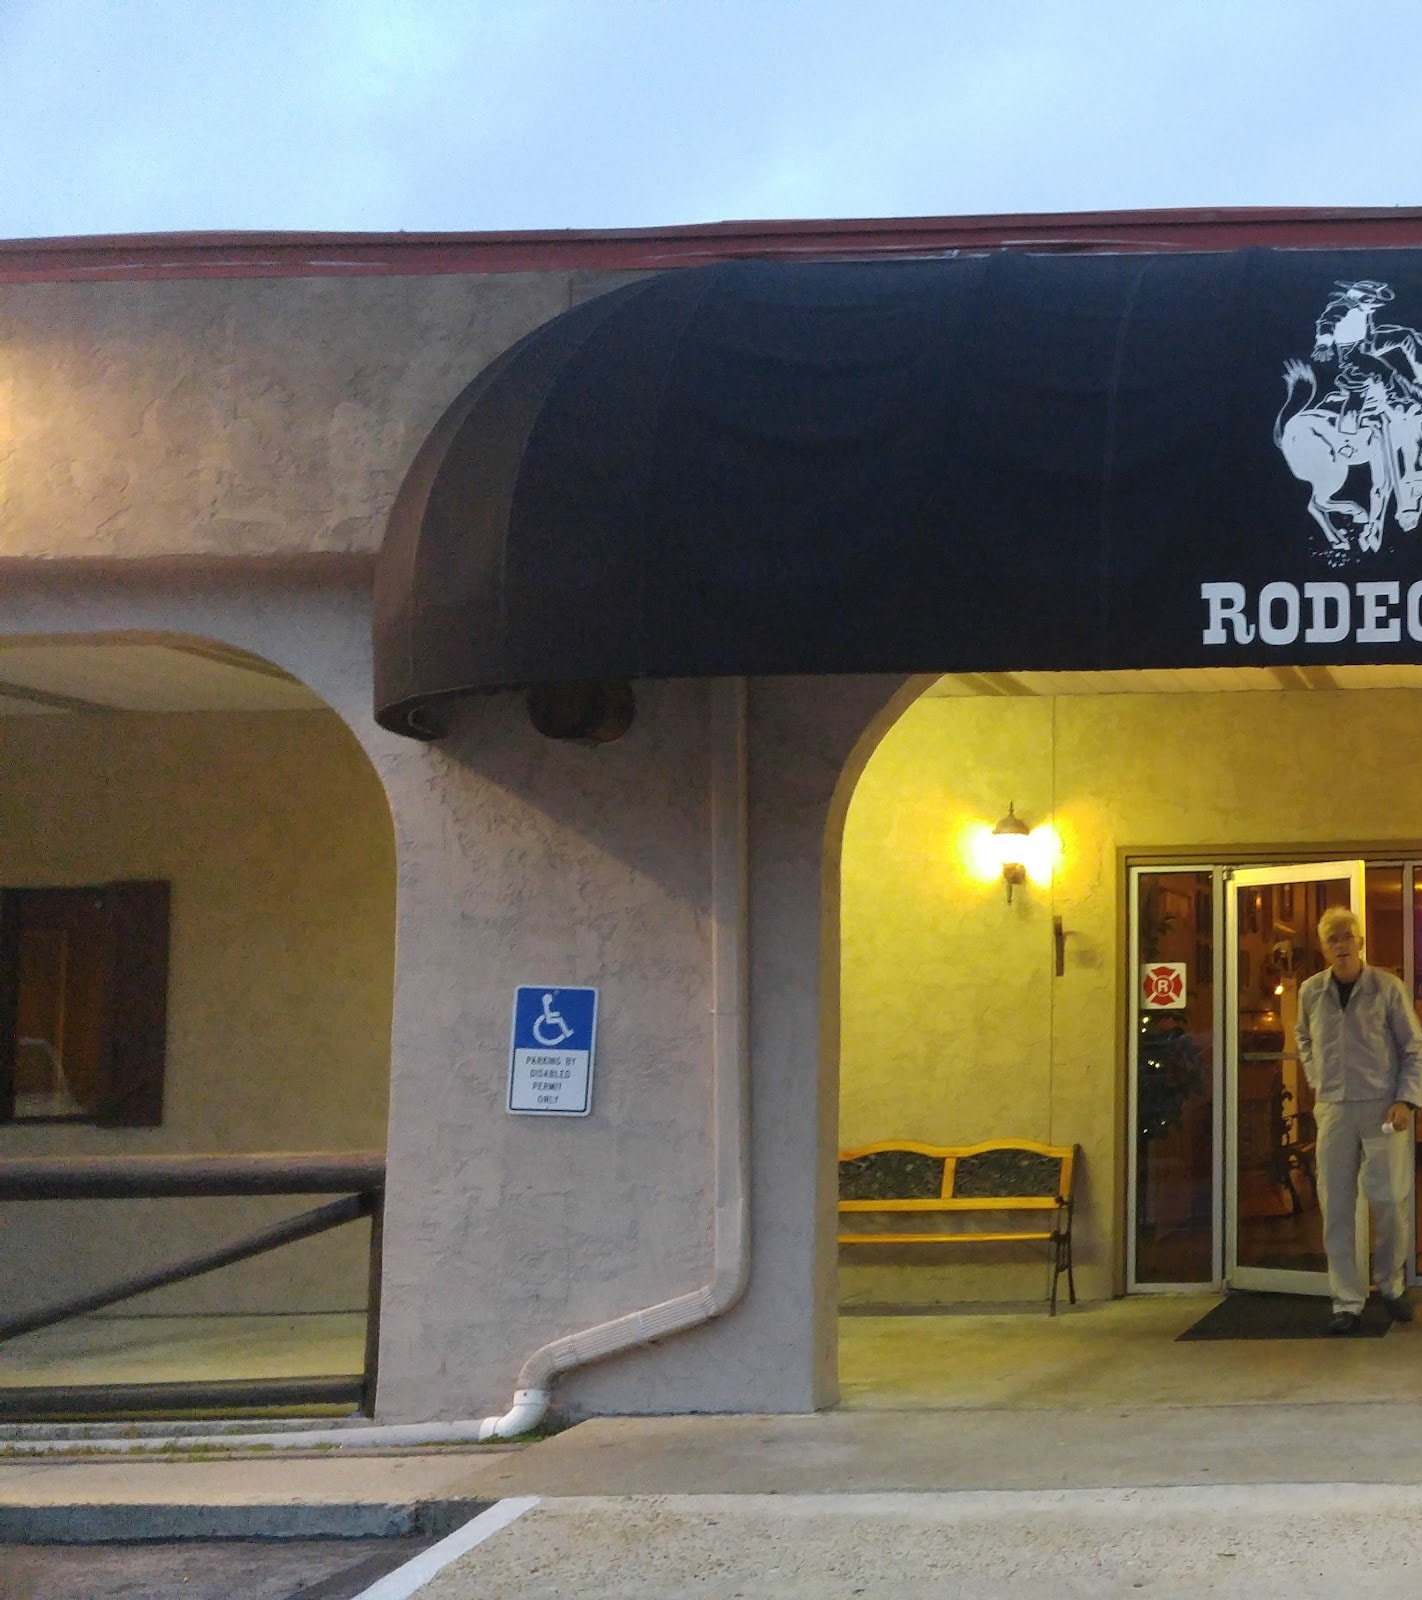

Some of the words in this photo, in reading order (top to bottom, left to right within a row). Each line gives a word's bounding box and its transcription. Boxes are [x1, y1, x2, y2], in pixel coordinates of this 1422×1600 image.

[1157, 979, 1169, 993] R
[525, 1056, 561, 1065] PARKING
[565, 1057, 576, 1066] BY
[530, 1069, 571, 1079] DISABLED
[532, 1081, 562, 1091] PERMIT
[537, 1095, 559, 1104] ONLY
